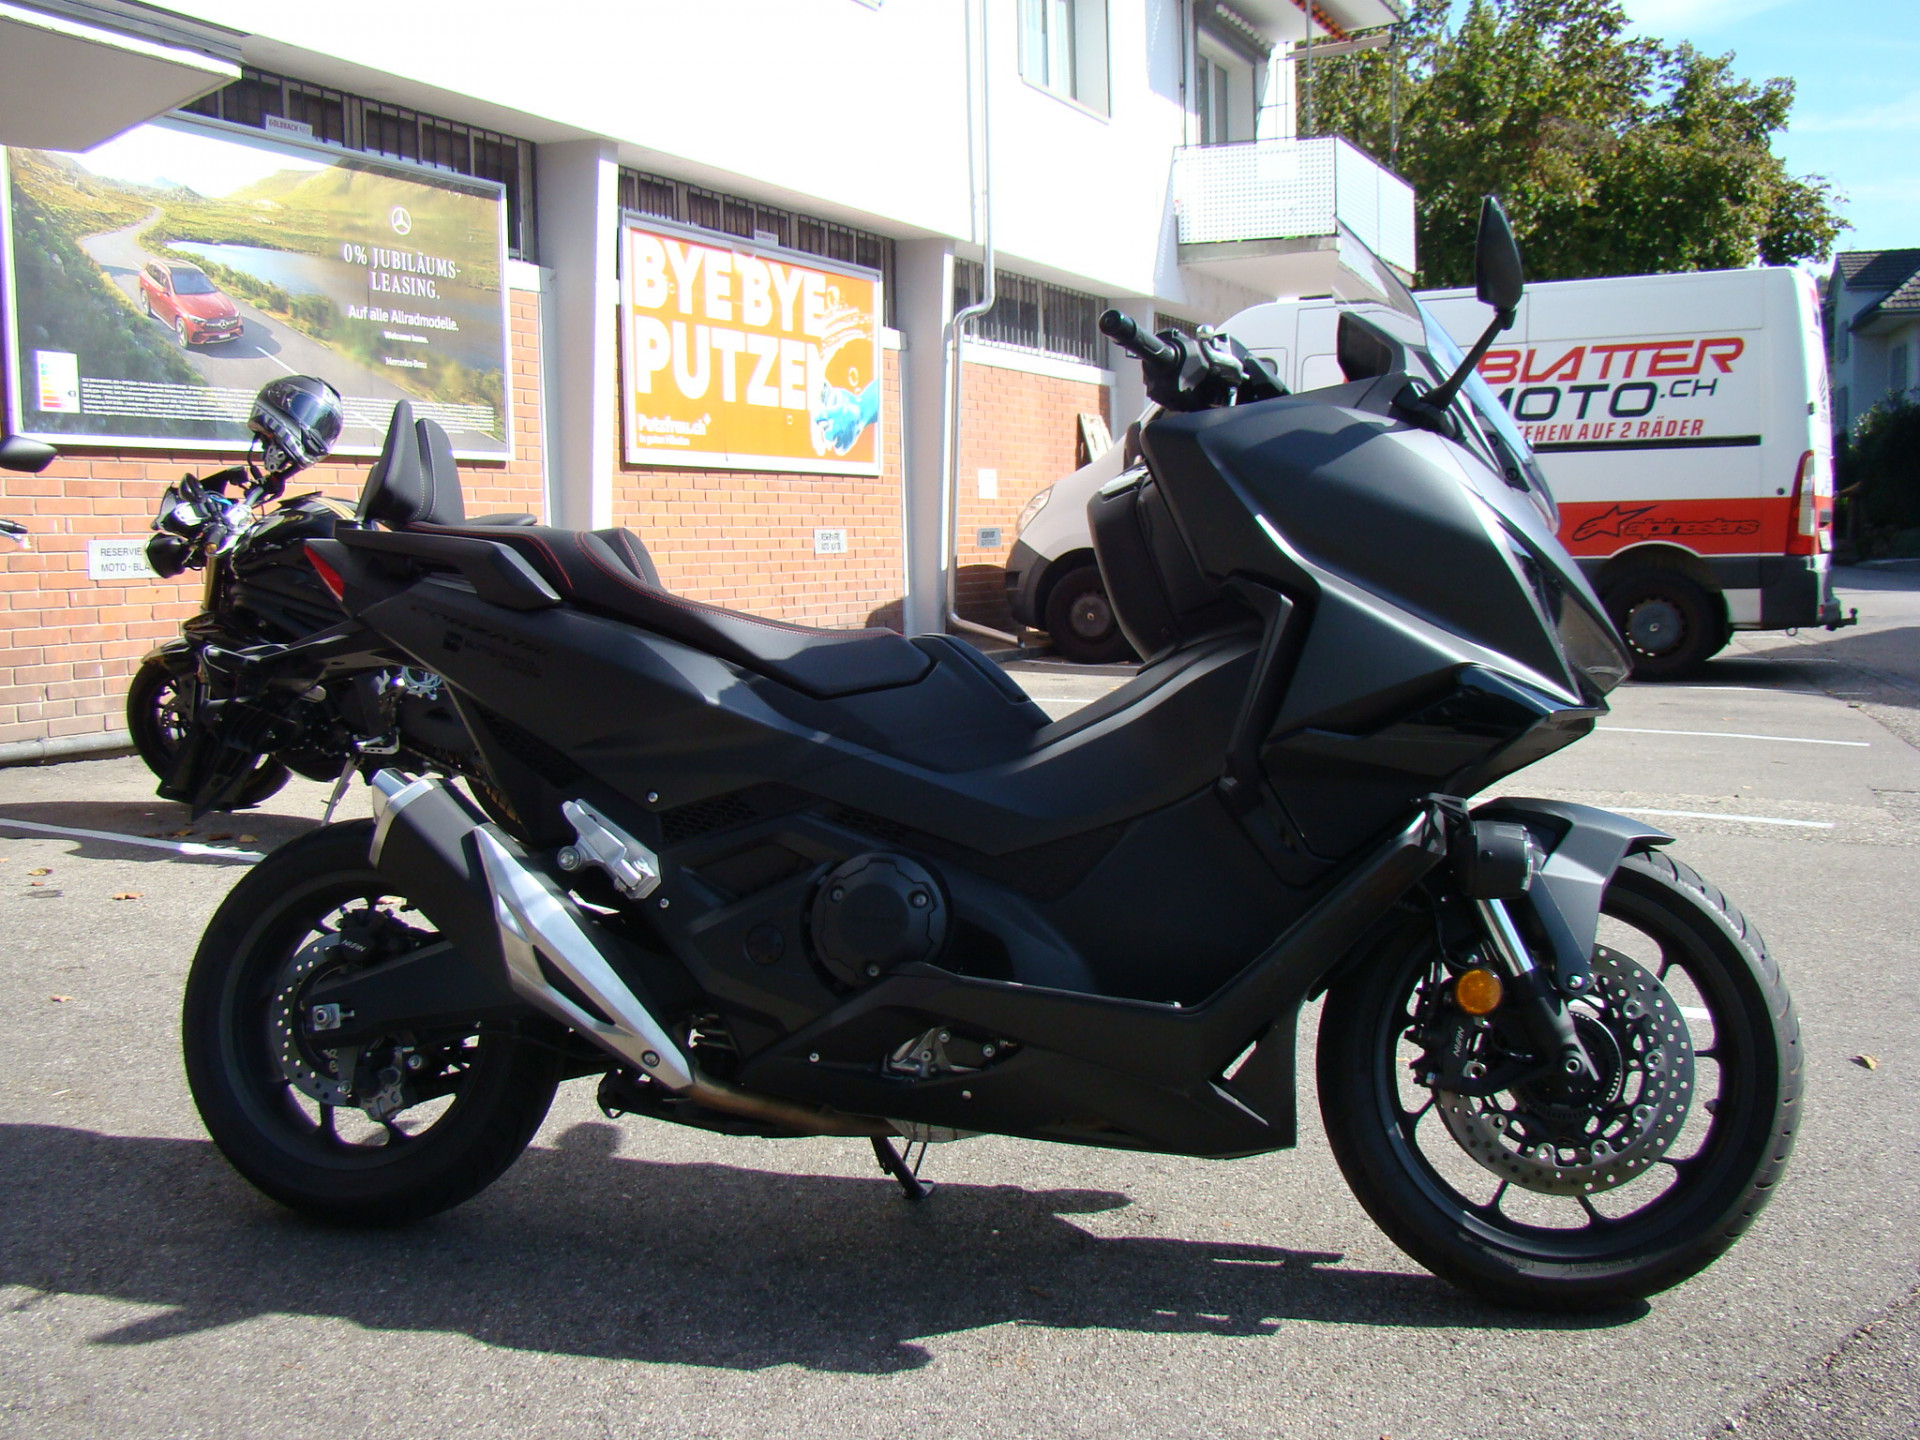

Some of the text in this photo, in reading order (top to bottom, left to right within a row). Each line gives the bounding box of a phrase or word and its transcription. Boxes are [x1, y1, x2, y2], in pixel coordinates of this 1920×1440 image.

[371, 246, 461, 279] JUBILÄUMS-
[371, 271, 440, 300] LEASING.
[633, 230, 827, 338] BYE BYE
[347, 304, 460, 332] Auf alle Allradmodelle.
[385, 356, 428, 369] Mercedes-Benz
[1477, 336, 1745, 385] BLATTER
[1516, 416, 1705, 441] EHEN AUF 2 RÄDER
[100, 547, 143, 557] RESERVIE
